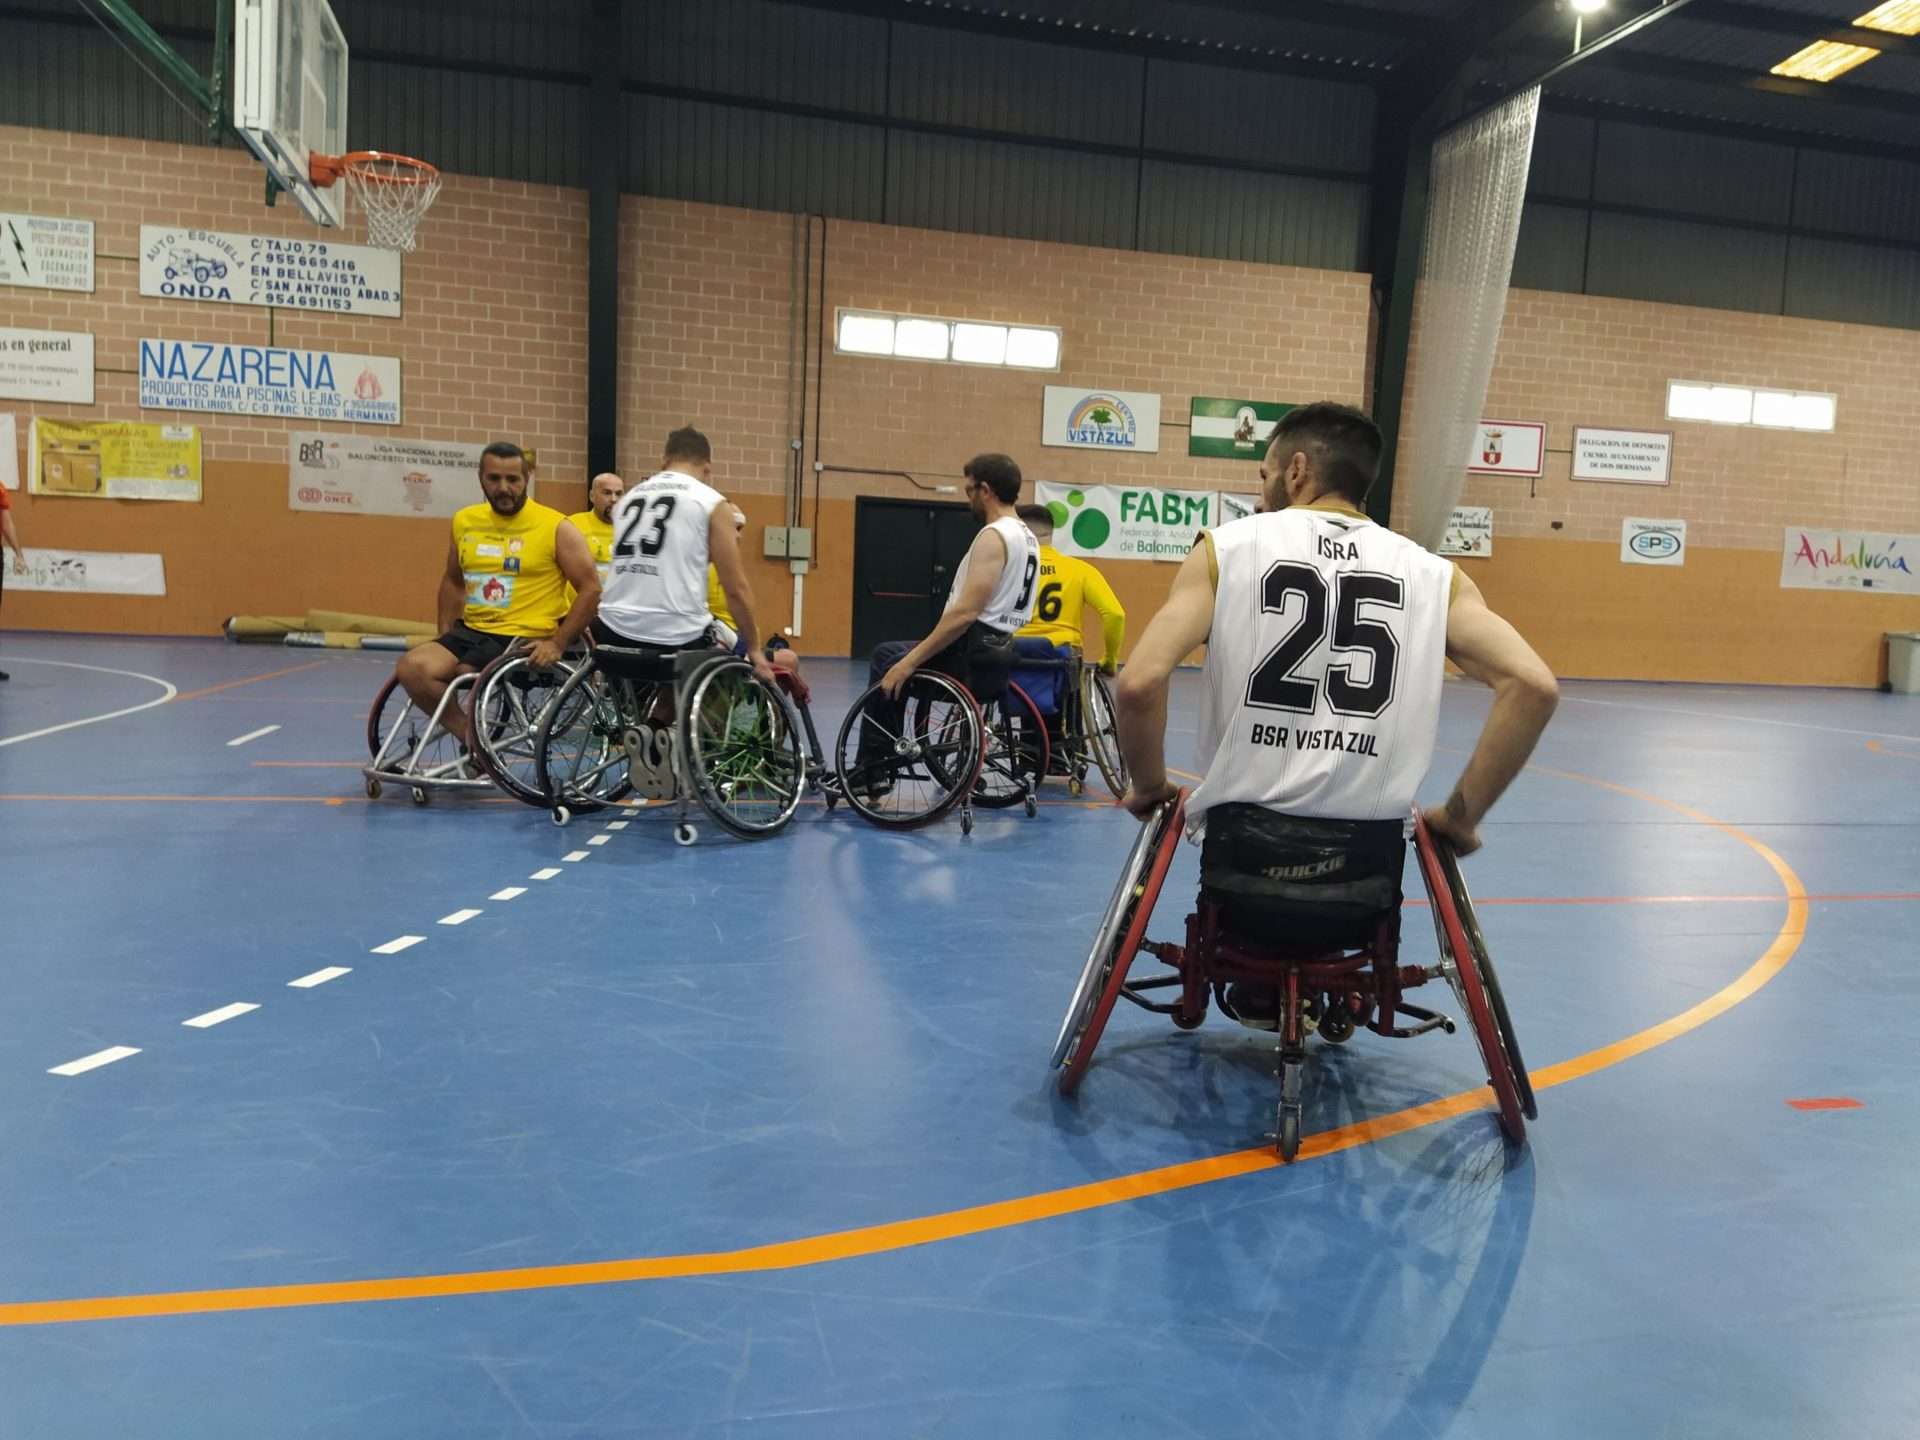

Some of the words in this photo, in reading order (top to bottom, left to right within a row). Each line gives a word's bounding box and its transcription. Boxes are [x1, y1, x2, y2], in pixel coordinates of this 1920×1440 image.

[308, 244, 327, 255] 79
[251, 265, 269, 277] EN
[277, 268, 366, 286] BELLAVISTA
[160, 282, 231, 300] ONDA
[266, 280, 289, 291] SAN
[297, 283, 351, 297] ANTONIO
[11, 340, 25, 351] en
[28, 337, 71, 354] general
[142, 340, 335, 391] NAZARENA
[141, 380, 209, 398] PRODUCTOS
[214, 385, 241, 400] PARA
[247, 386, 296, 403] PISCINAS
[343, 408, 396, 421] HERMANAS
[1069, 430, 1133, 445] VISTAZUL
[348, 452, 404, 463] BALONCESTO
[395, 446, 436, 457] NACIONAL
[1120, 491, 1208, 527] FABM
[613, 494, 677, 559] 23
[1120, 540, 1134, 552] de
[1137, 540, 1192, 555] Balonma
[1318, 535, 1359, 560] ISRA
[1639, 536, 1673, 550] SPS
[1793, 533, 1912, 575] Andalucía
[1014, 552, 1037, 613] 9
[1244, 559, 1405, 720] 25
[1250, 723, 1289, 748] BSR
[1296, 729, 1378, 758] VISTAZUL
